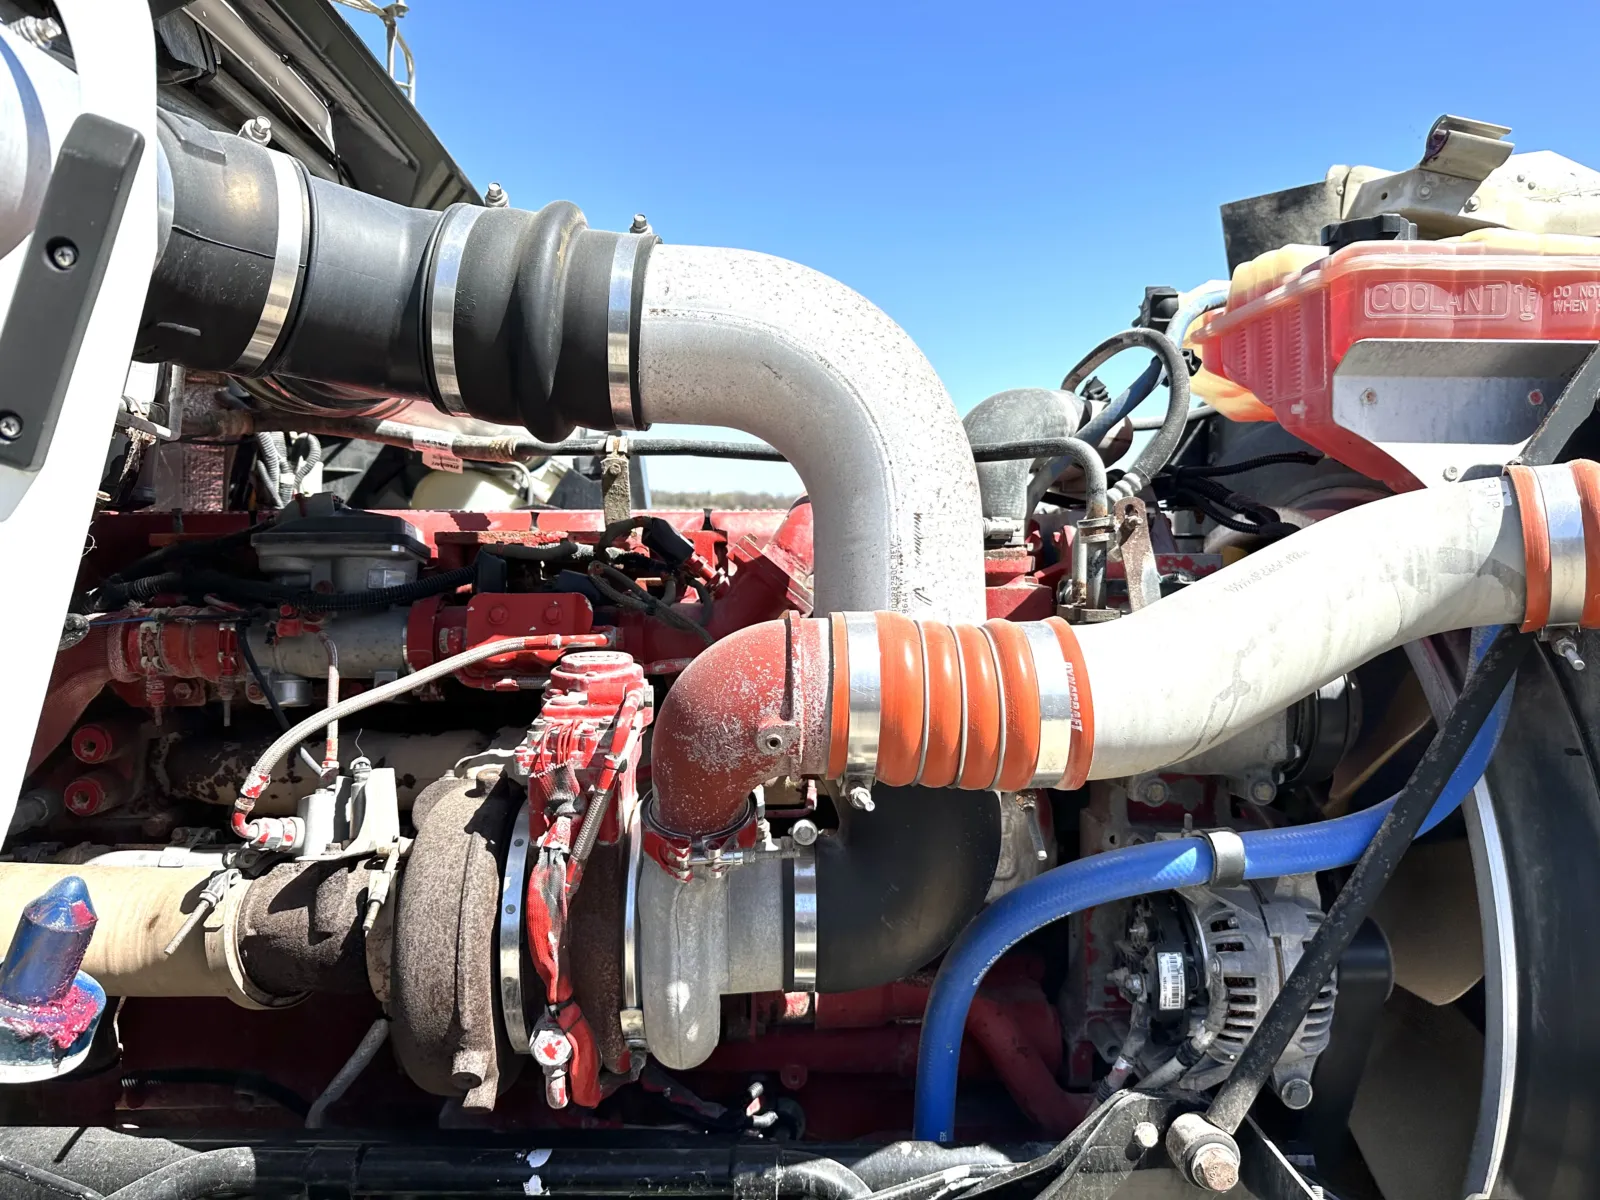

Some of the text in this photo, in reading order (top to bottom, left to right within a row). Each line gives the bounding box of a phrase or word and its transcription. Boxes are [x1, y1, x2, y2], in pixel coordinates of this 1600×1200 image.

[1371, 284, 1503, 312] COOLANT
[1553, 285, 1572, 298] DO
[1553, 300, 1589, 312] WHEN
